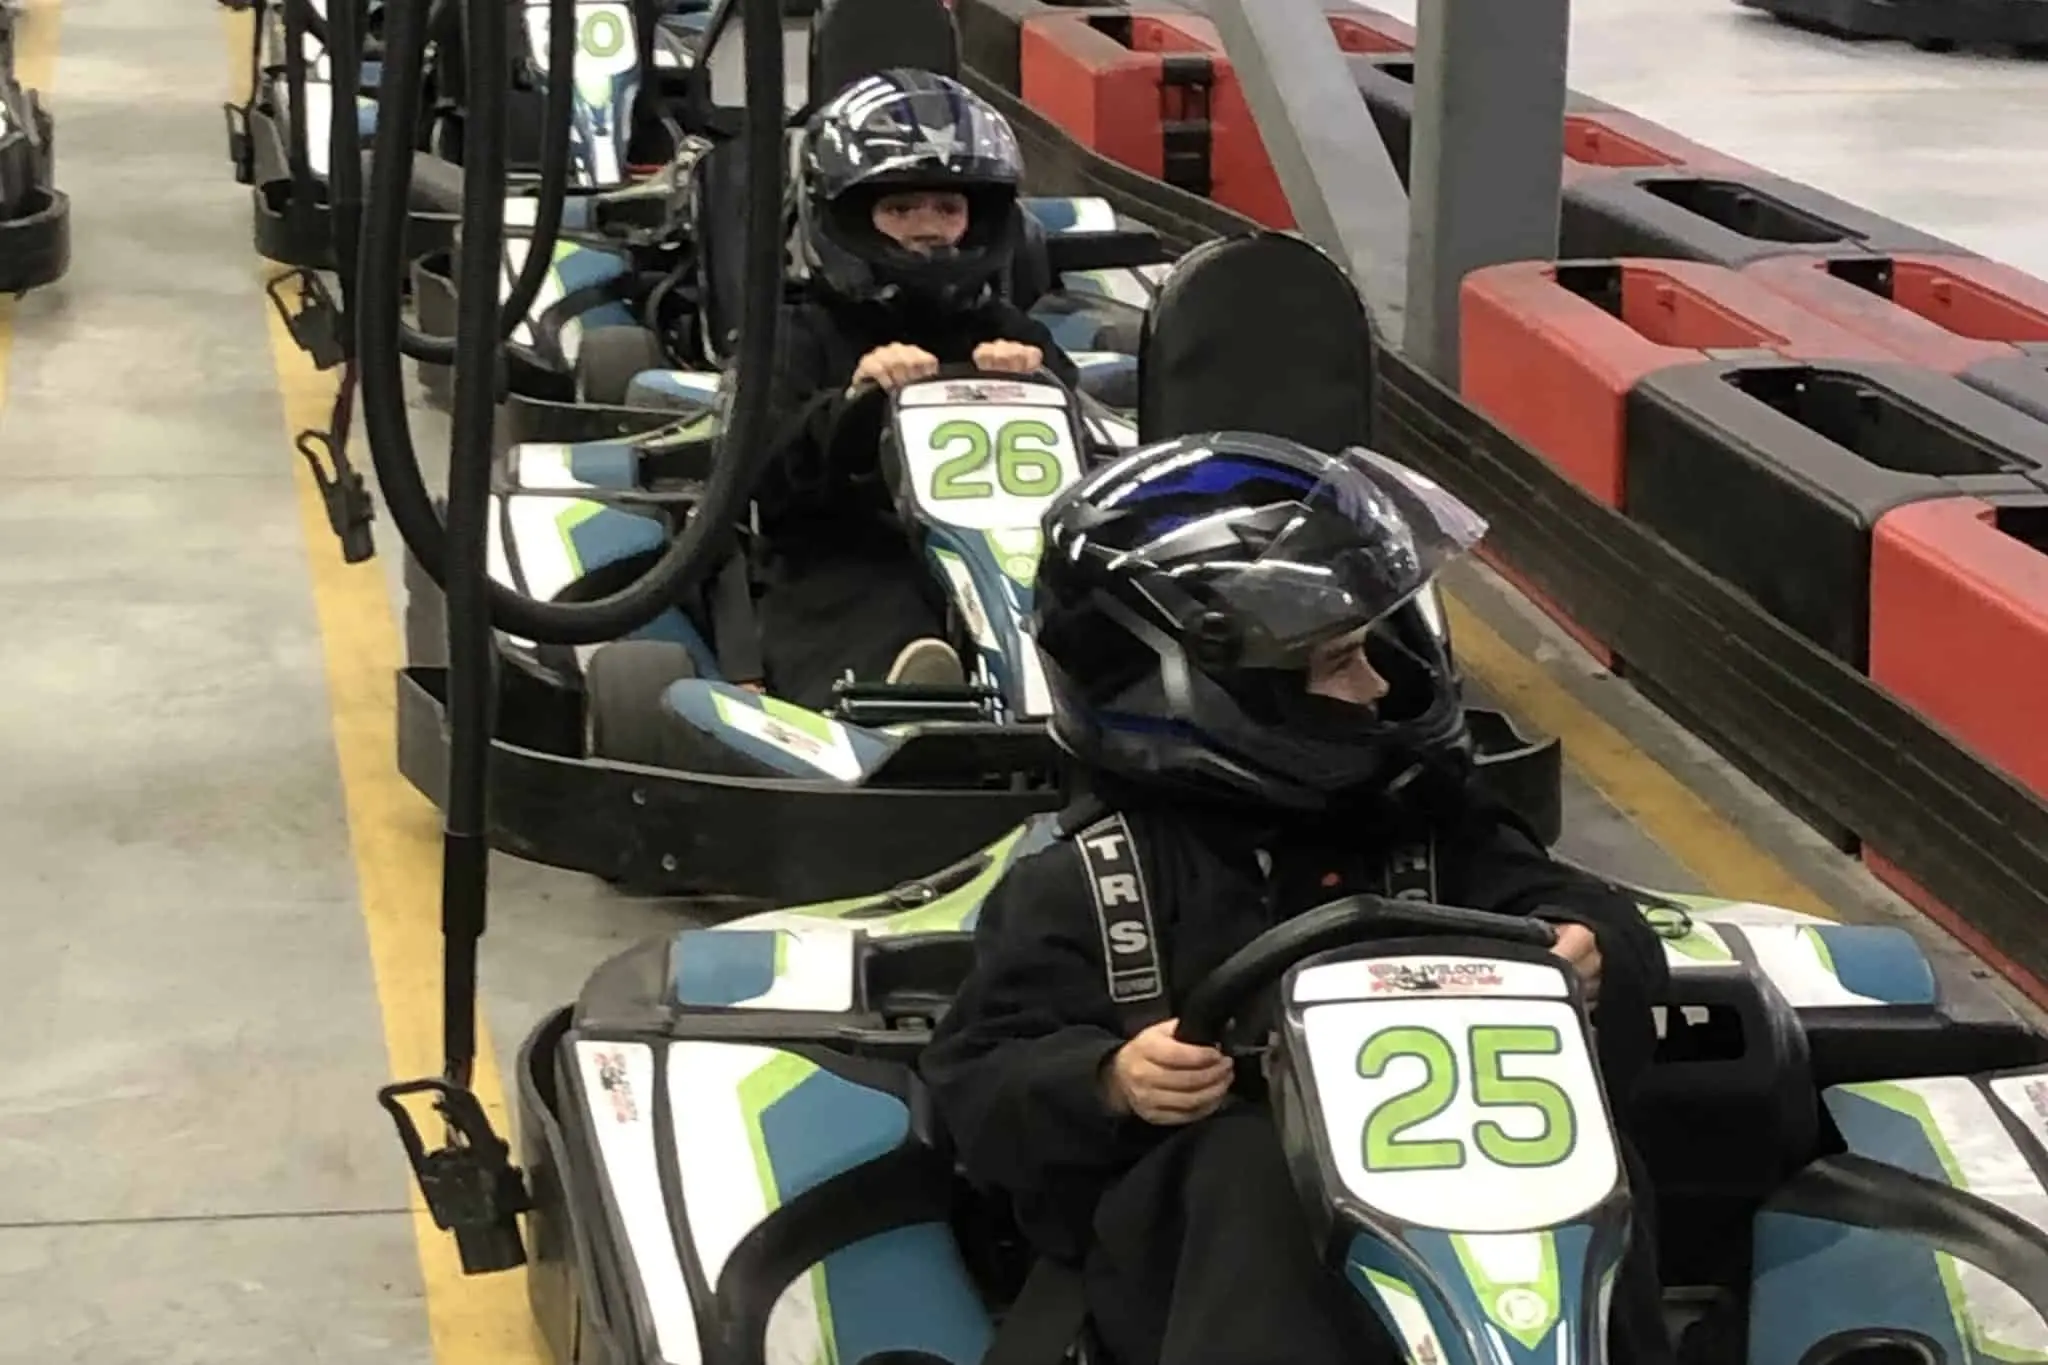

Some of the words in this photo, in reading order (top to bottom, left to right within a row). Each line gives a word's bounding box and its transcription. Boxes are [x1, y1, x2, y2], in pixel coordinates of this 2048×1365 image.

[928, 419, 1062, 500] 26
[1087, 834, 1148, 954] TRS
[1356, 1025, 1578, 1173] 25
